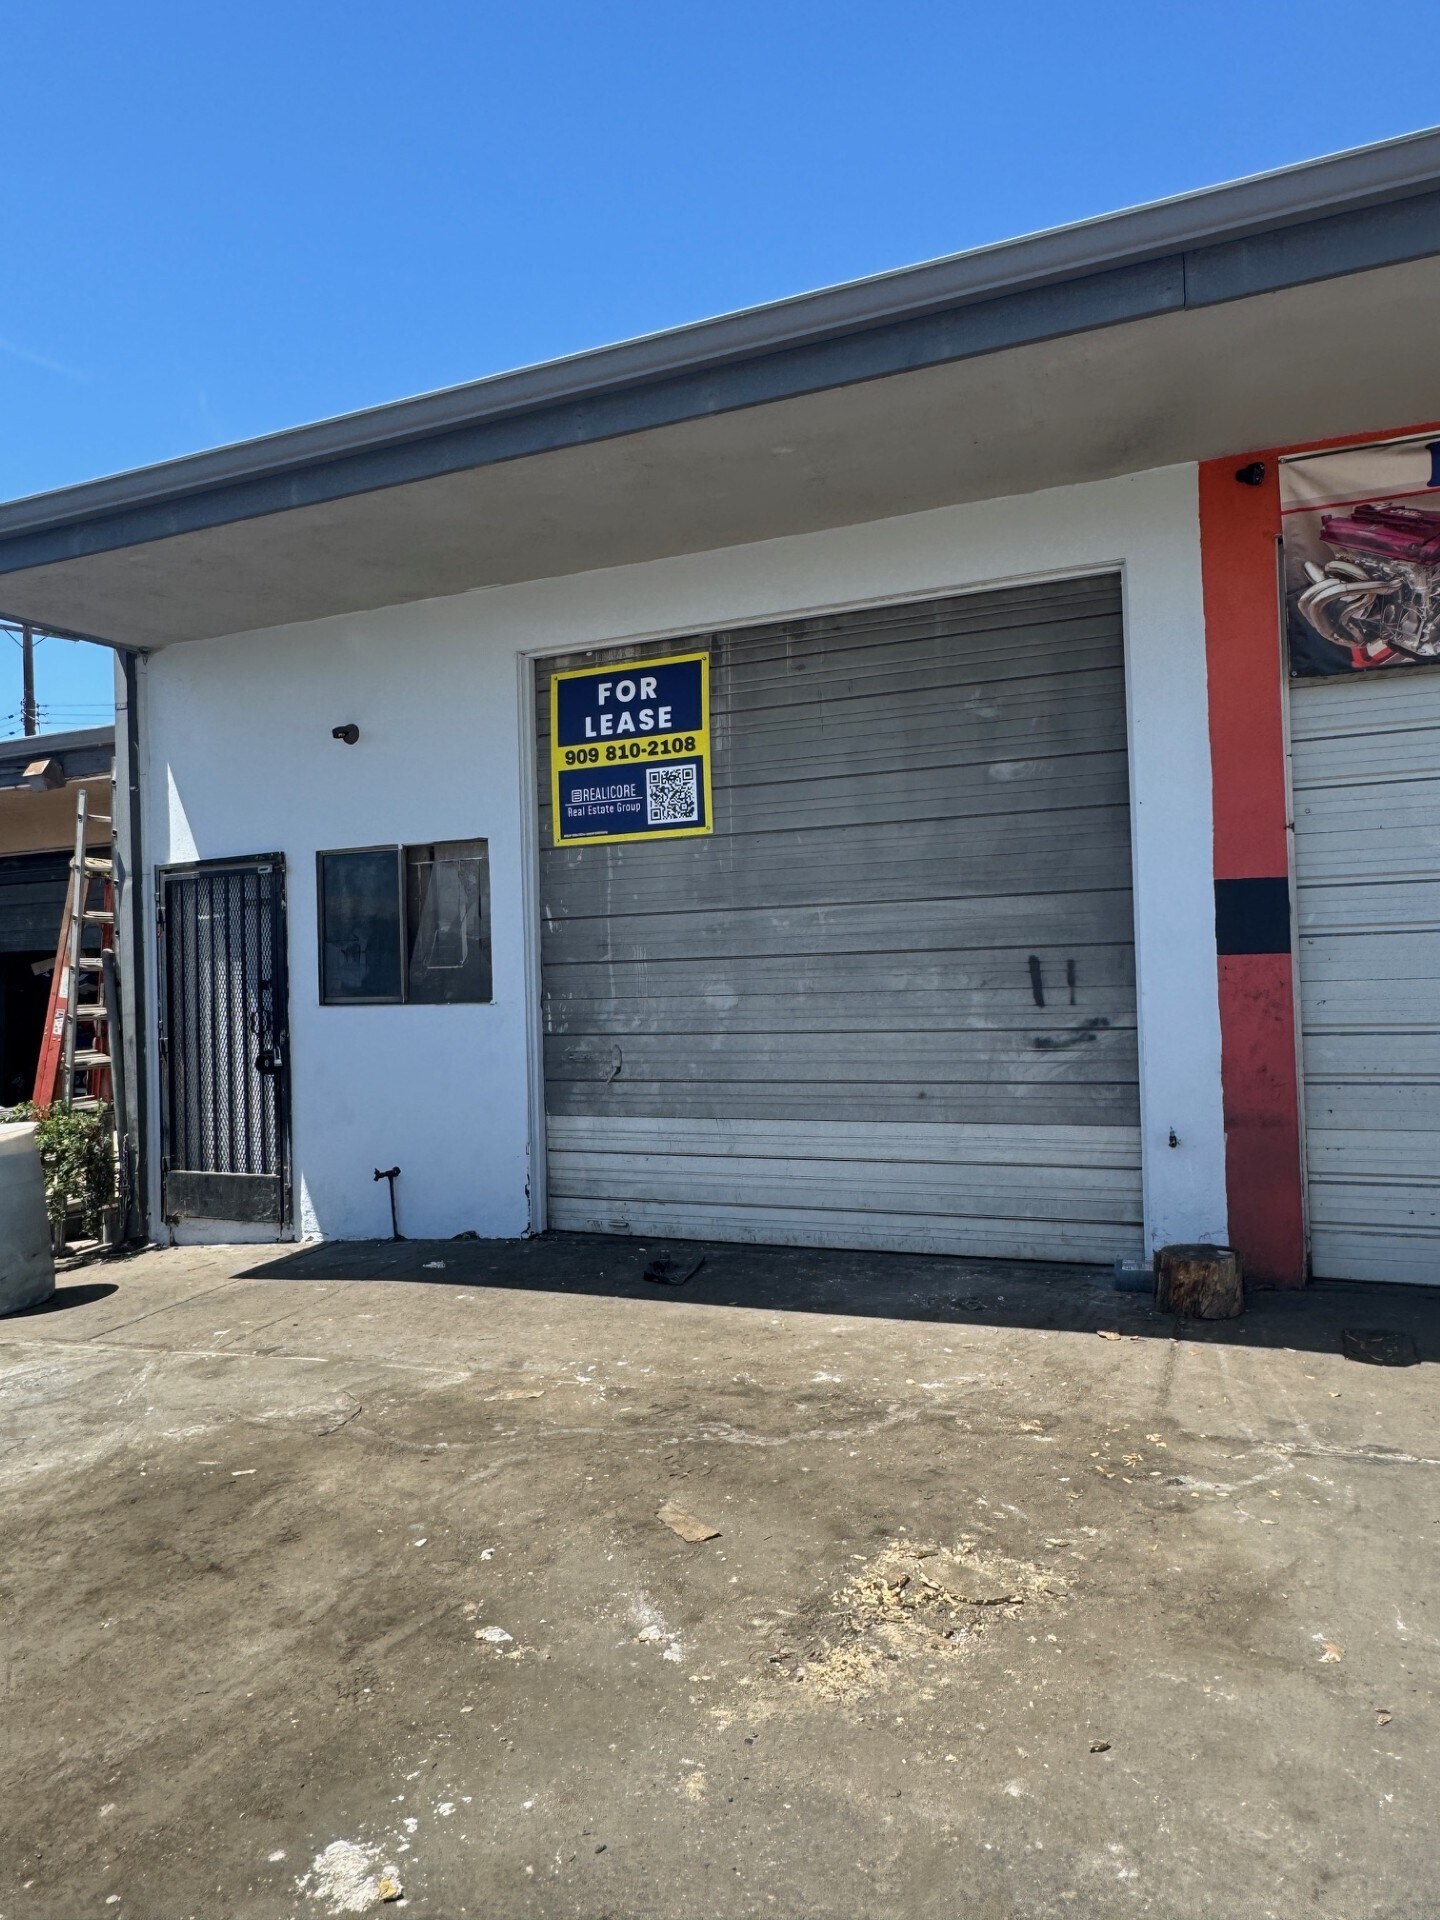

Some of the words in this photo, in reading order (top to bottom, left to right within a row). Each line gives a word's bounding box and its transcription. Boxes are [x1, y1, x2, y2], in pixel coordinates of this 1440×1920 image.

[598, 676, 658, 706] FOR
[585, 706, 672, 738] LEASE
[565, 747, 599, 766] 909
[605, 736, 696, 762] 810-2108
[568, 806, 585, 817] Real
[588, 805, 615, 815] Estate
[617, 802, 641, 812] Group
